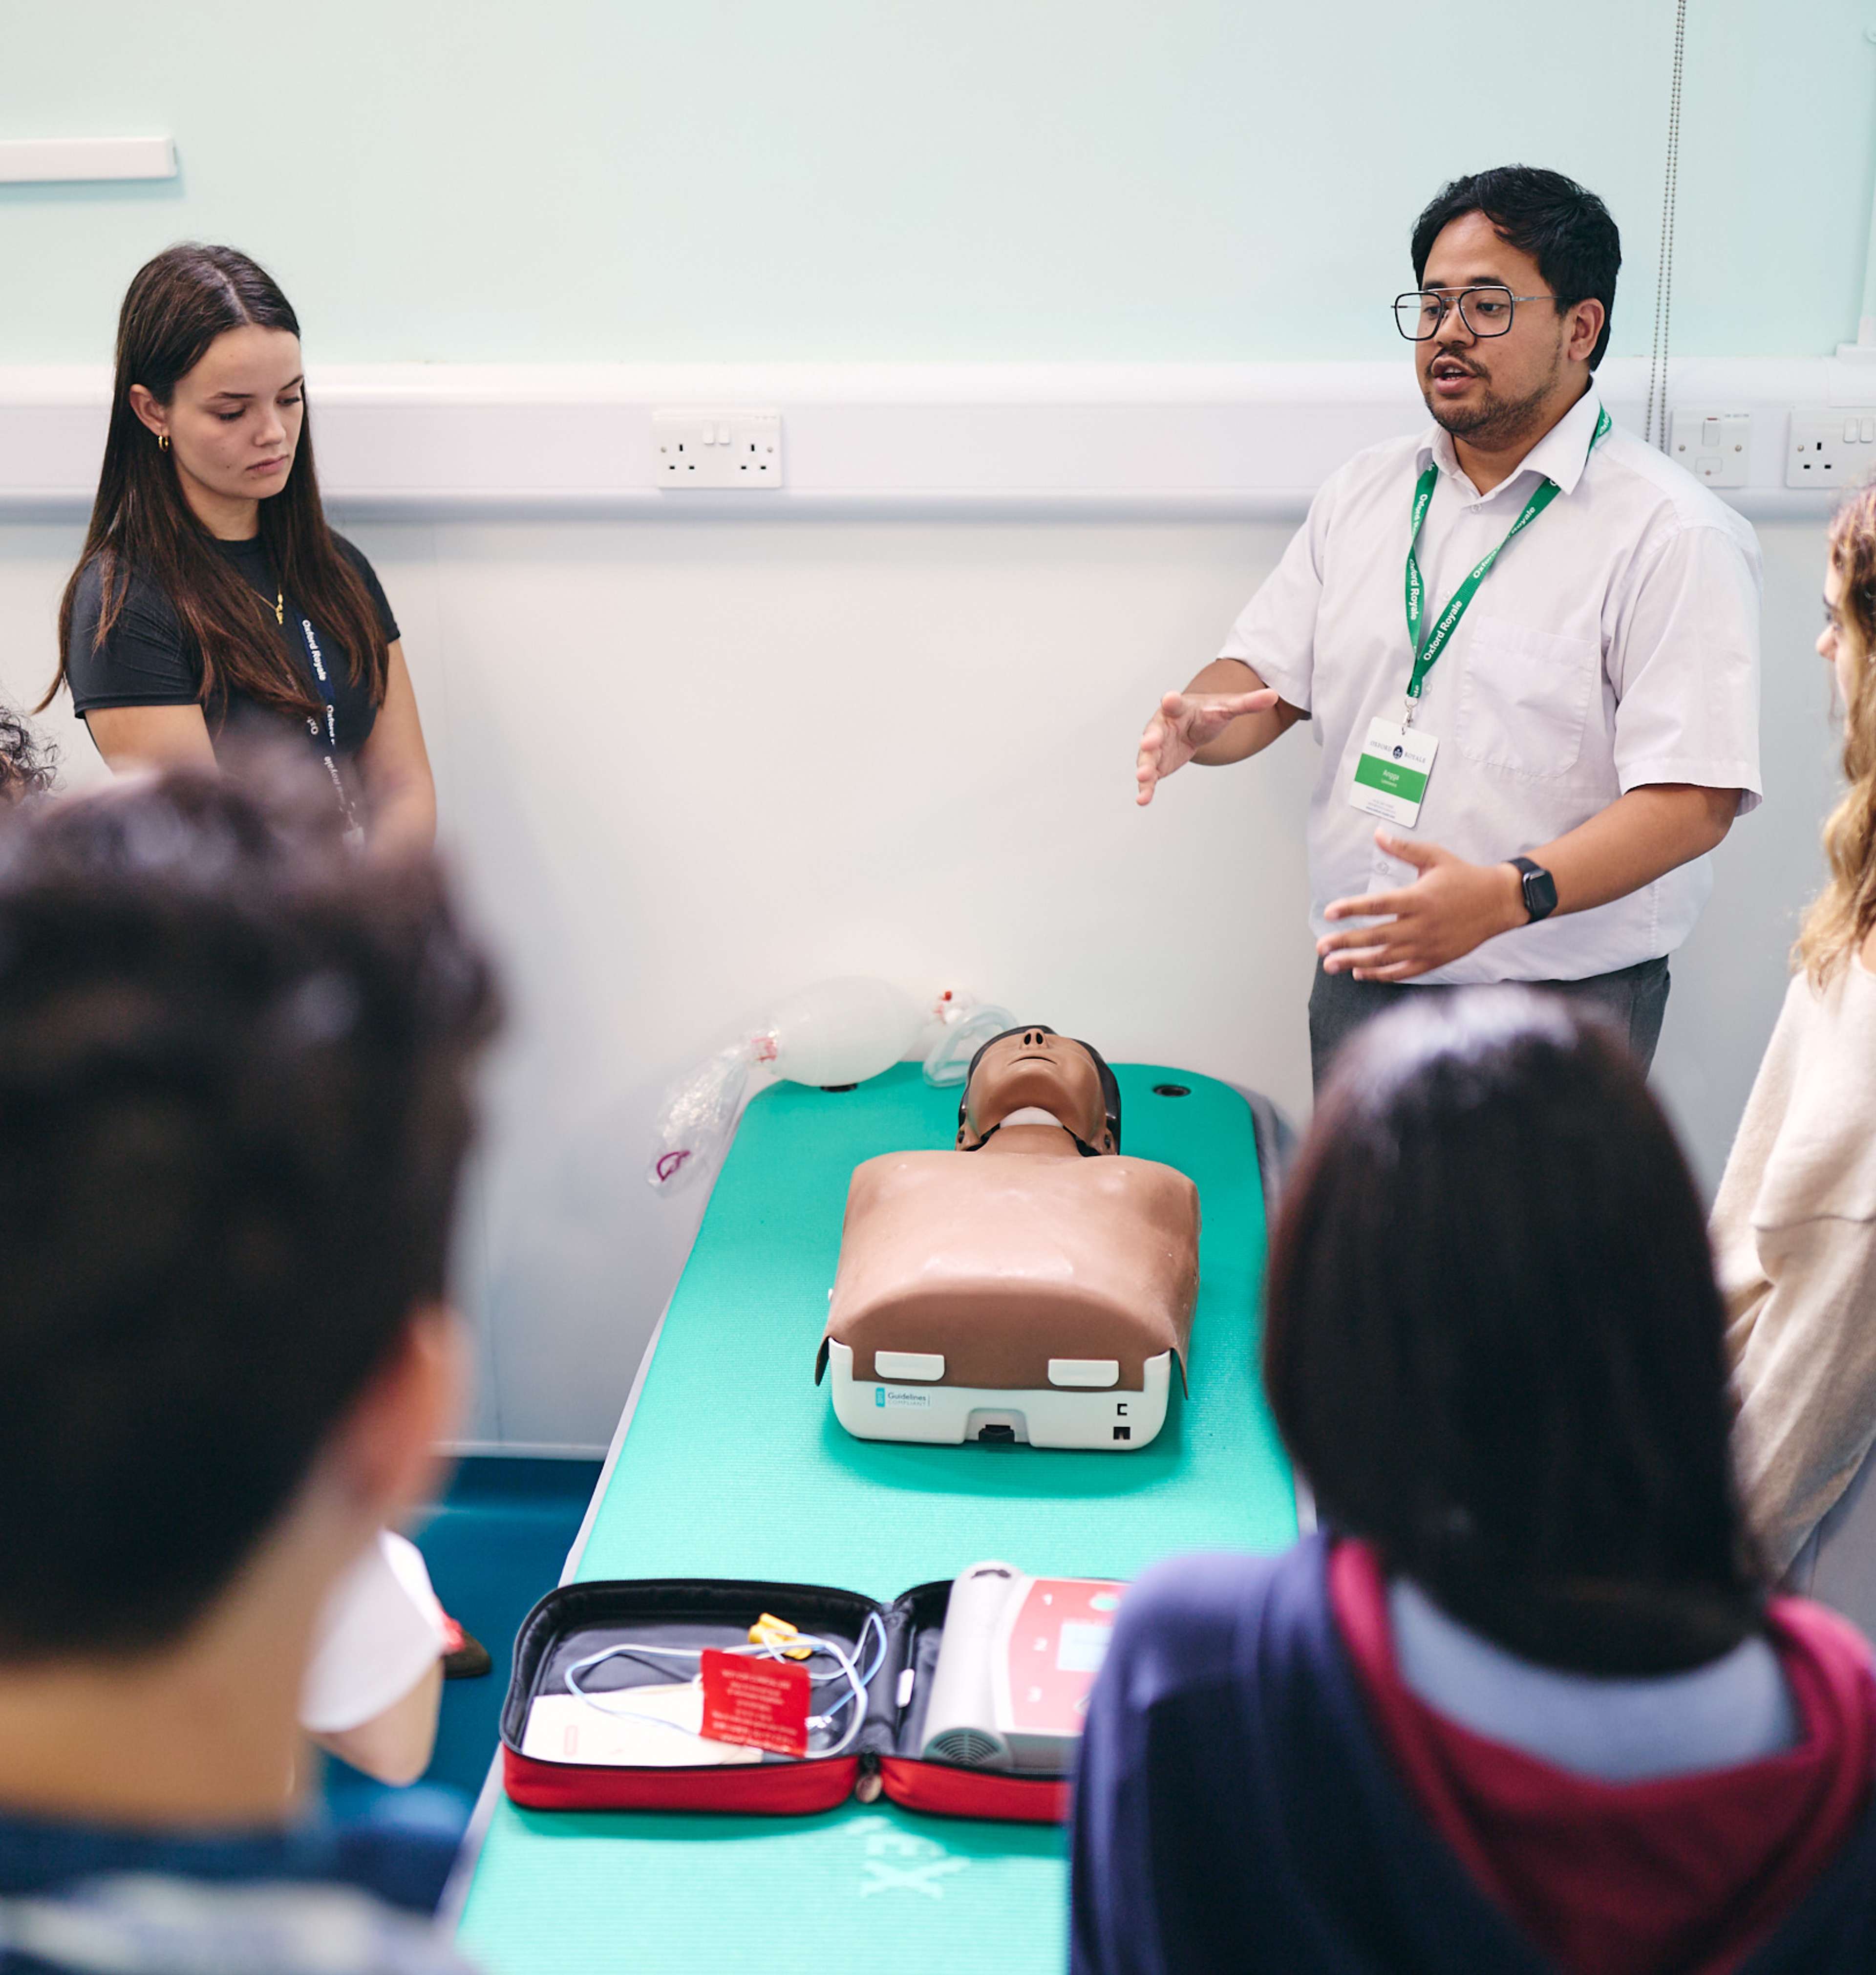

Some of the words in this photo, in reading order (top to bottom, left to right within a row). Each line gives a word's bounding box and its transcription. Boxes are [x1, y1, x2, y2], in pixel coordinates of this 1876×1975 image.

[1408, 588, 1420, 621] Royale
[1423, 630, 1445, 661] Oxford
[1440, 601, 1463, 631] Royale
[302, 620, 319, 650] Oxford
[311, 650, 326, 681] Royale
[306, 716, 319, 735] Oxf
[888, 1392, 927, 1401] Guidelines
